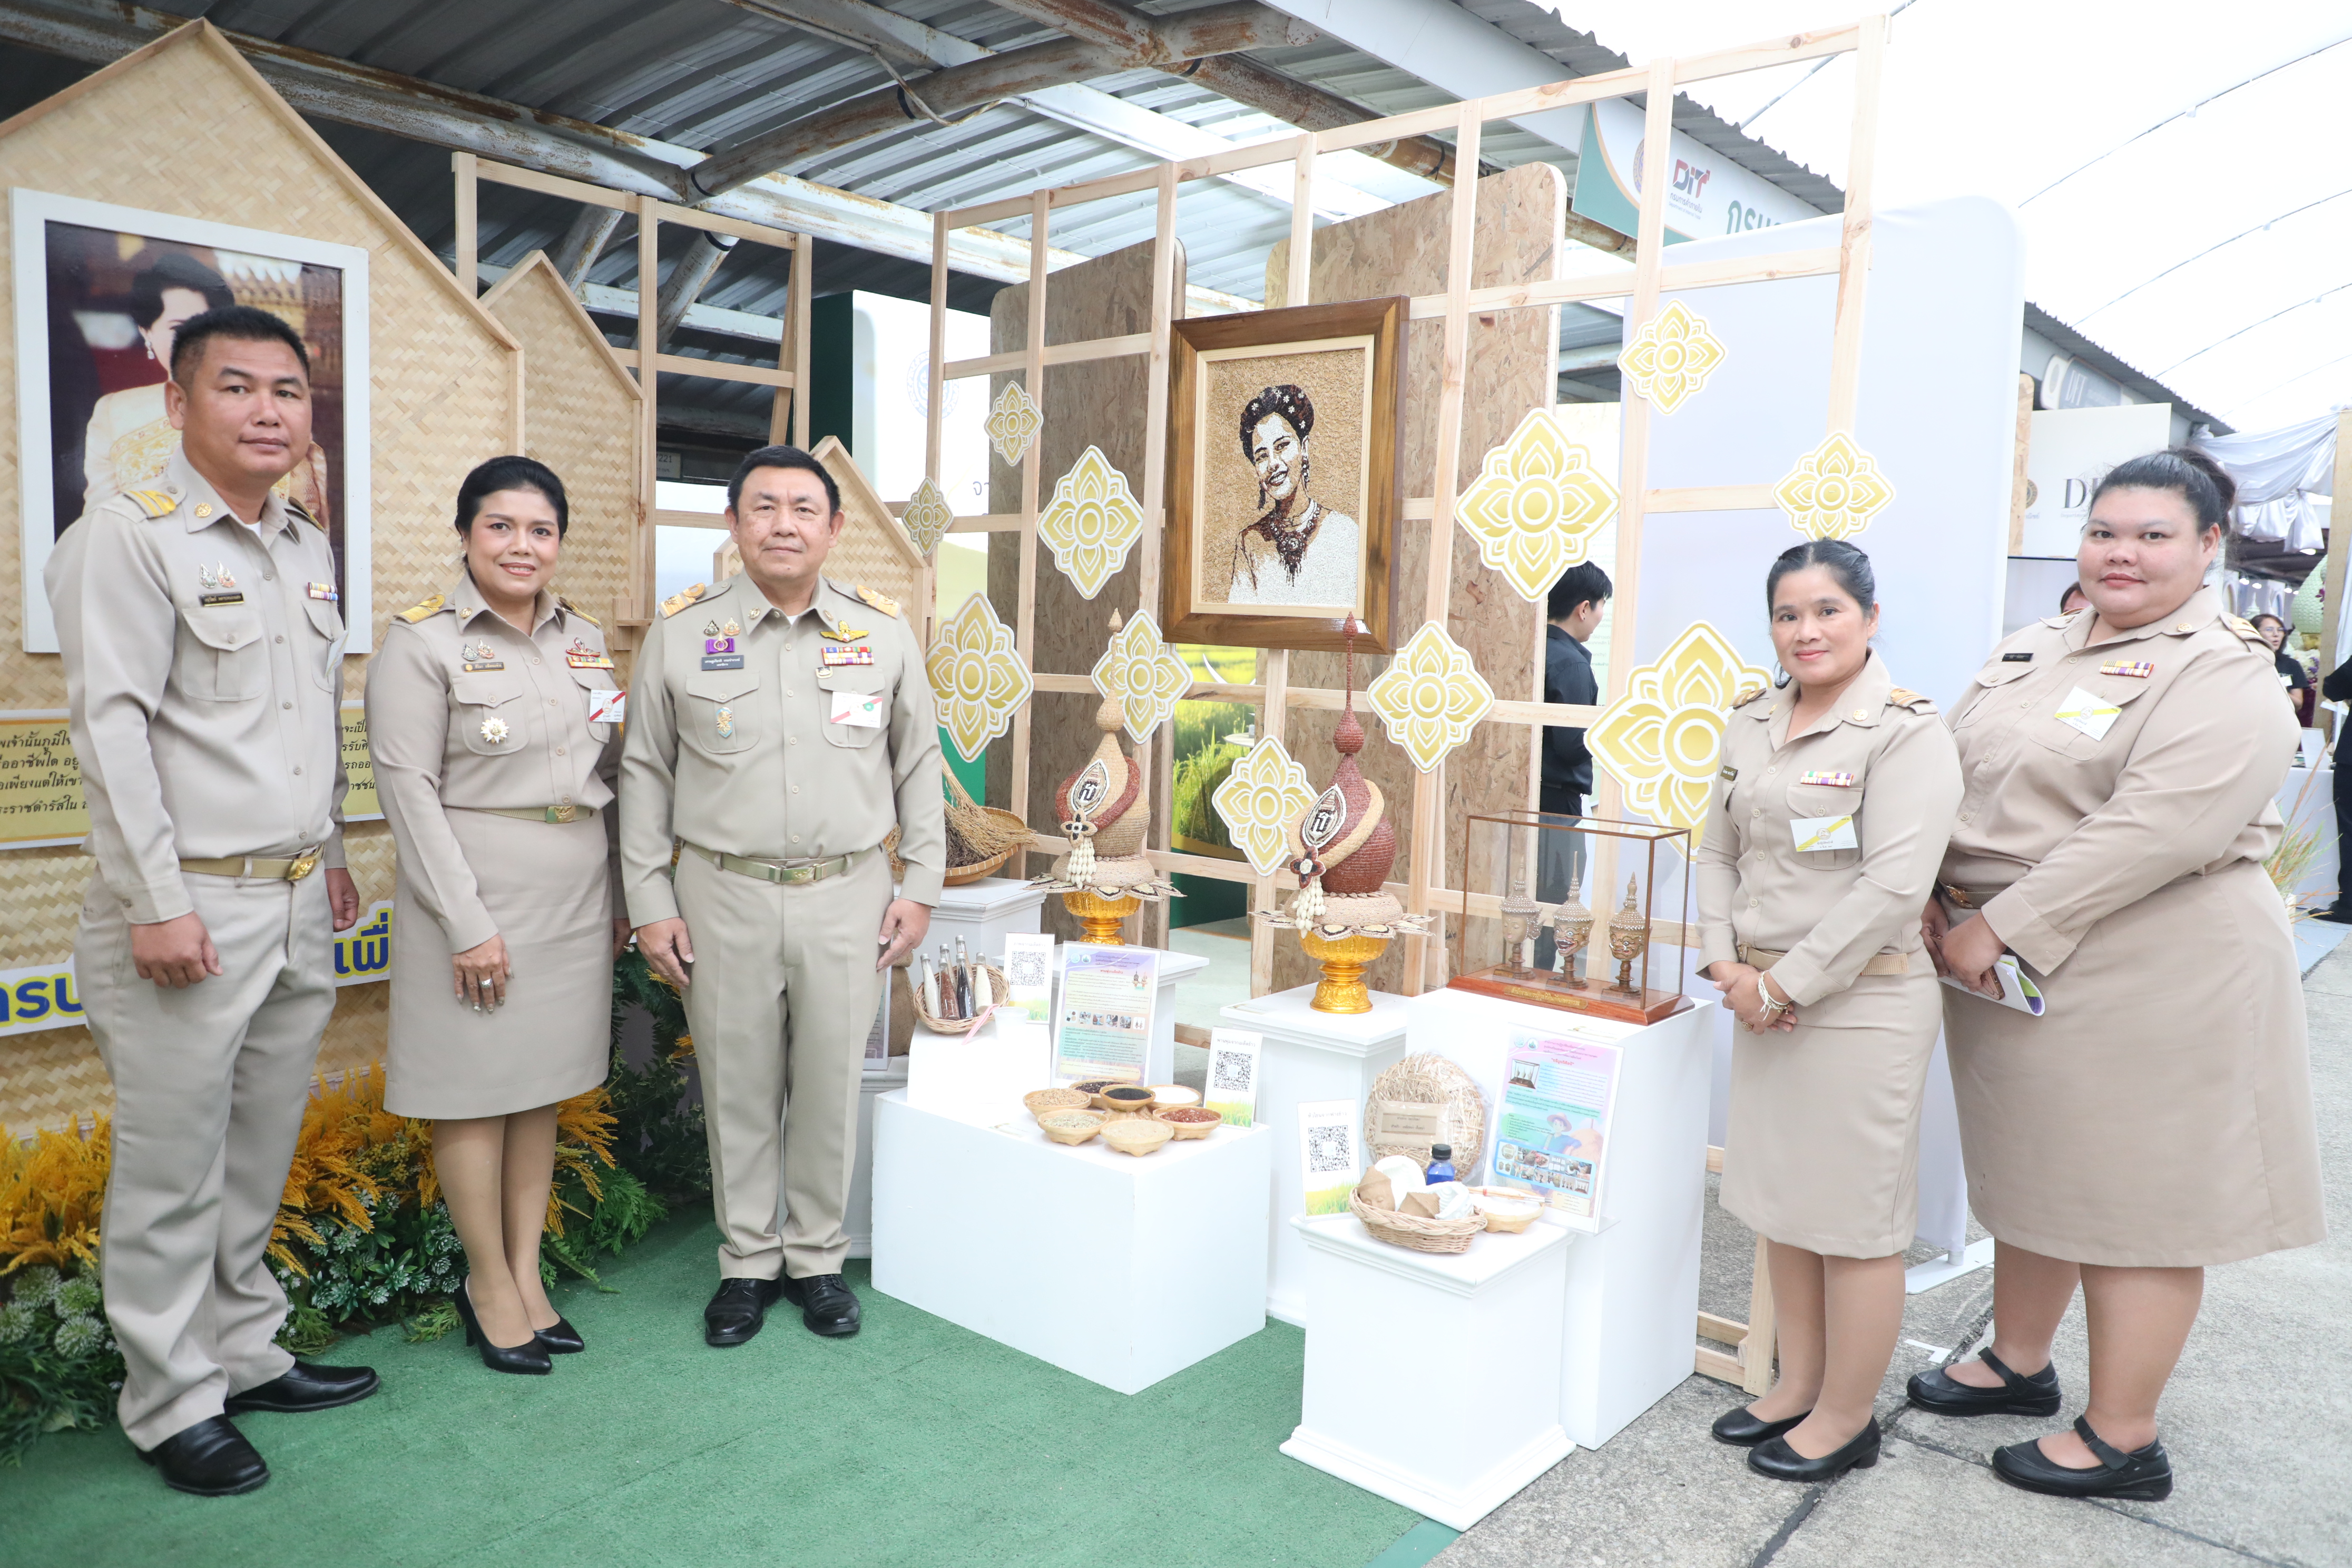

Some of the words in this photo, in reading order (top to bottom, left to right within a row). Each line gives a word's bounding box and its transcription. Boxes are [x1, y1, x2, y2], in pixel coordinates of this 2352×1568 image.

[1670, 192, 1703, 213] กรมการค้าภายใน
[656, 454, 672, 463] 221
[1217, 1038, 1256, 1047] พานพุ่มจากเมล็ดข้าว
